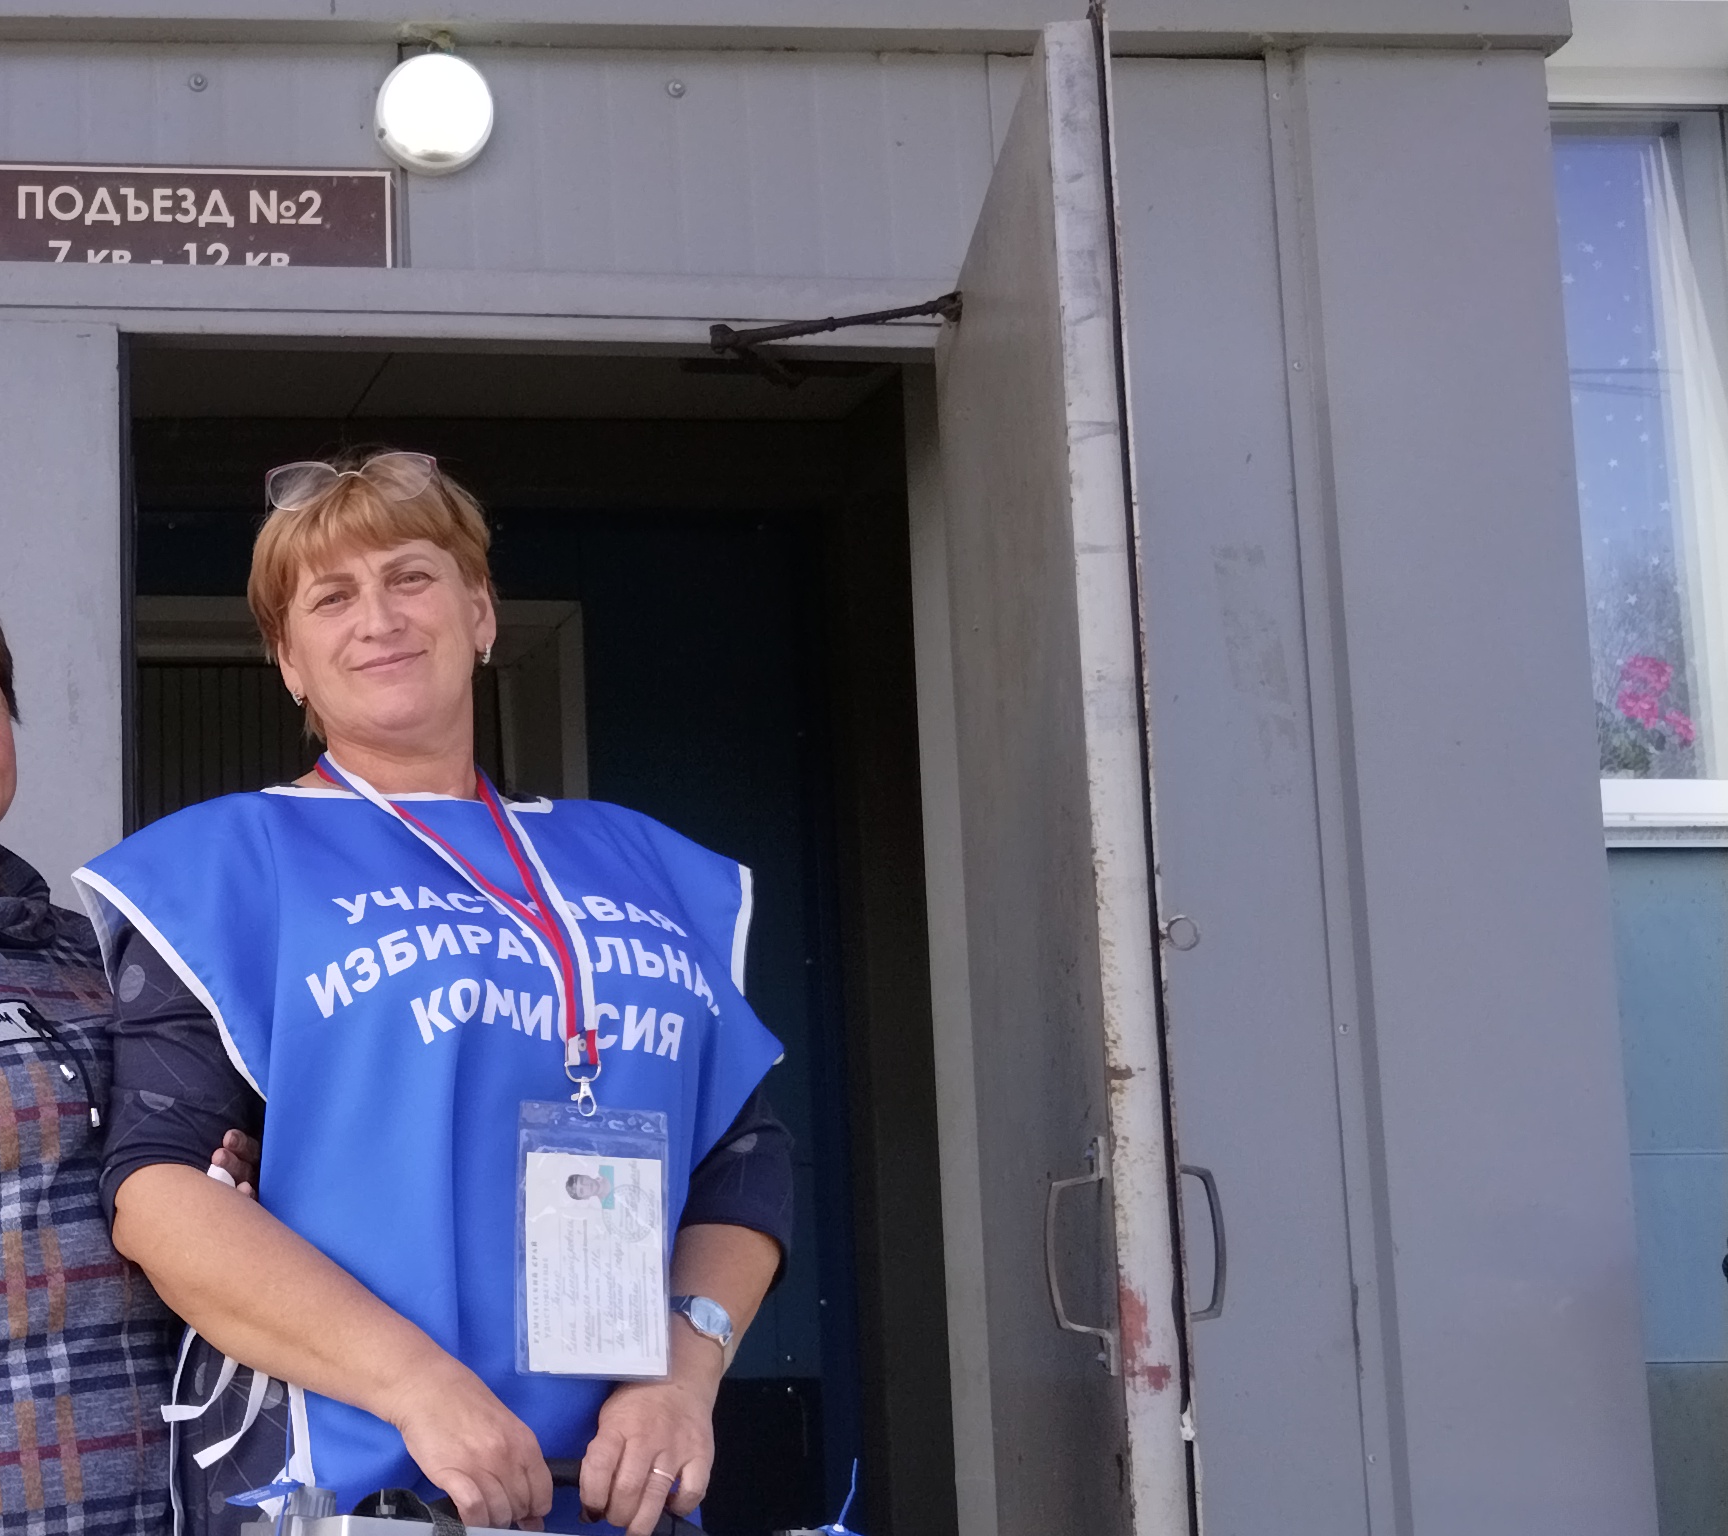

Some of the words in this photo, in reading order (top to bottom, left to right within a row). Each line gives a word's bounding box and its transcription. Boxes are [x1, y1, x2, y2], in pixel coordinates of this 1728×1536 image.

[17, 185, 235, 228] ПОДЪЕЗД
[248, 189, 323, 226] №2
[182, 242, 230, 266] 12
